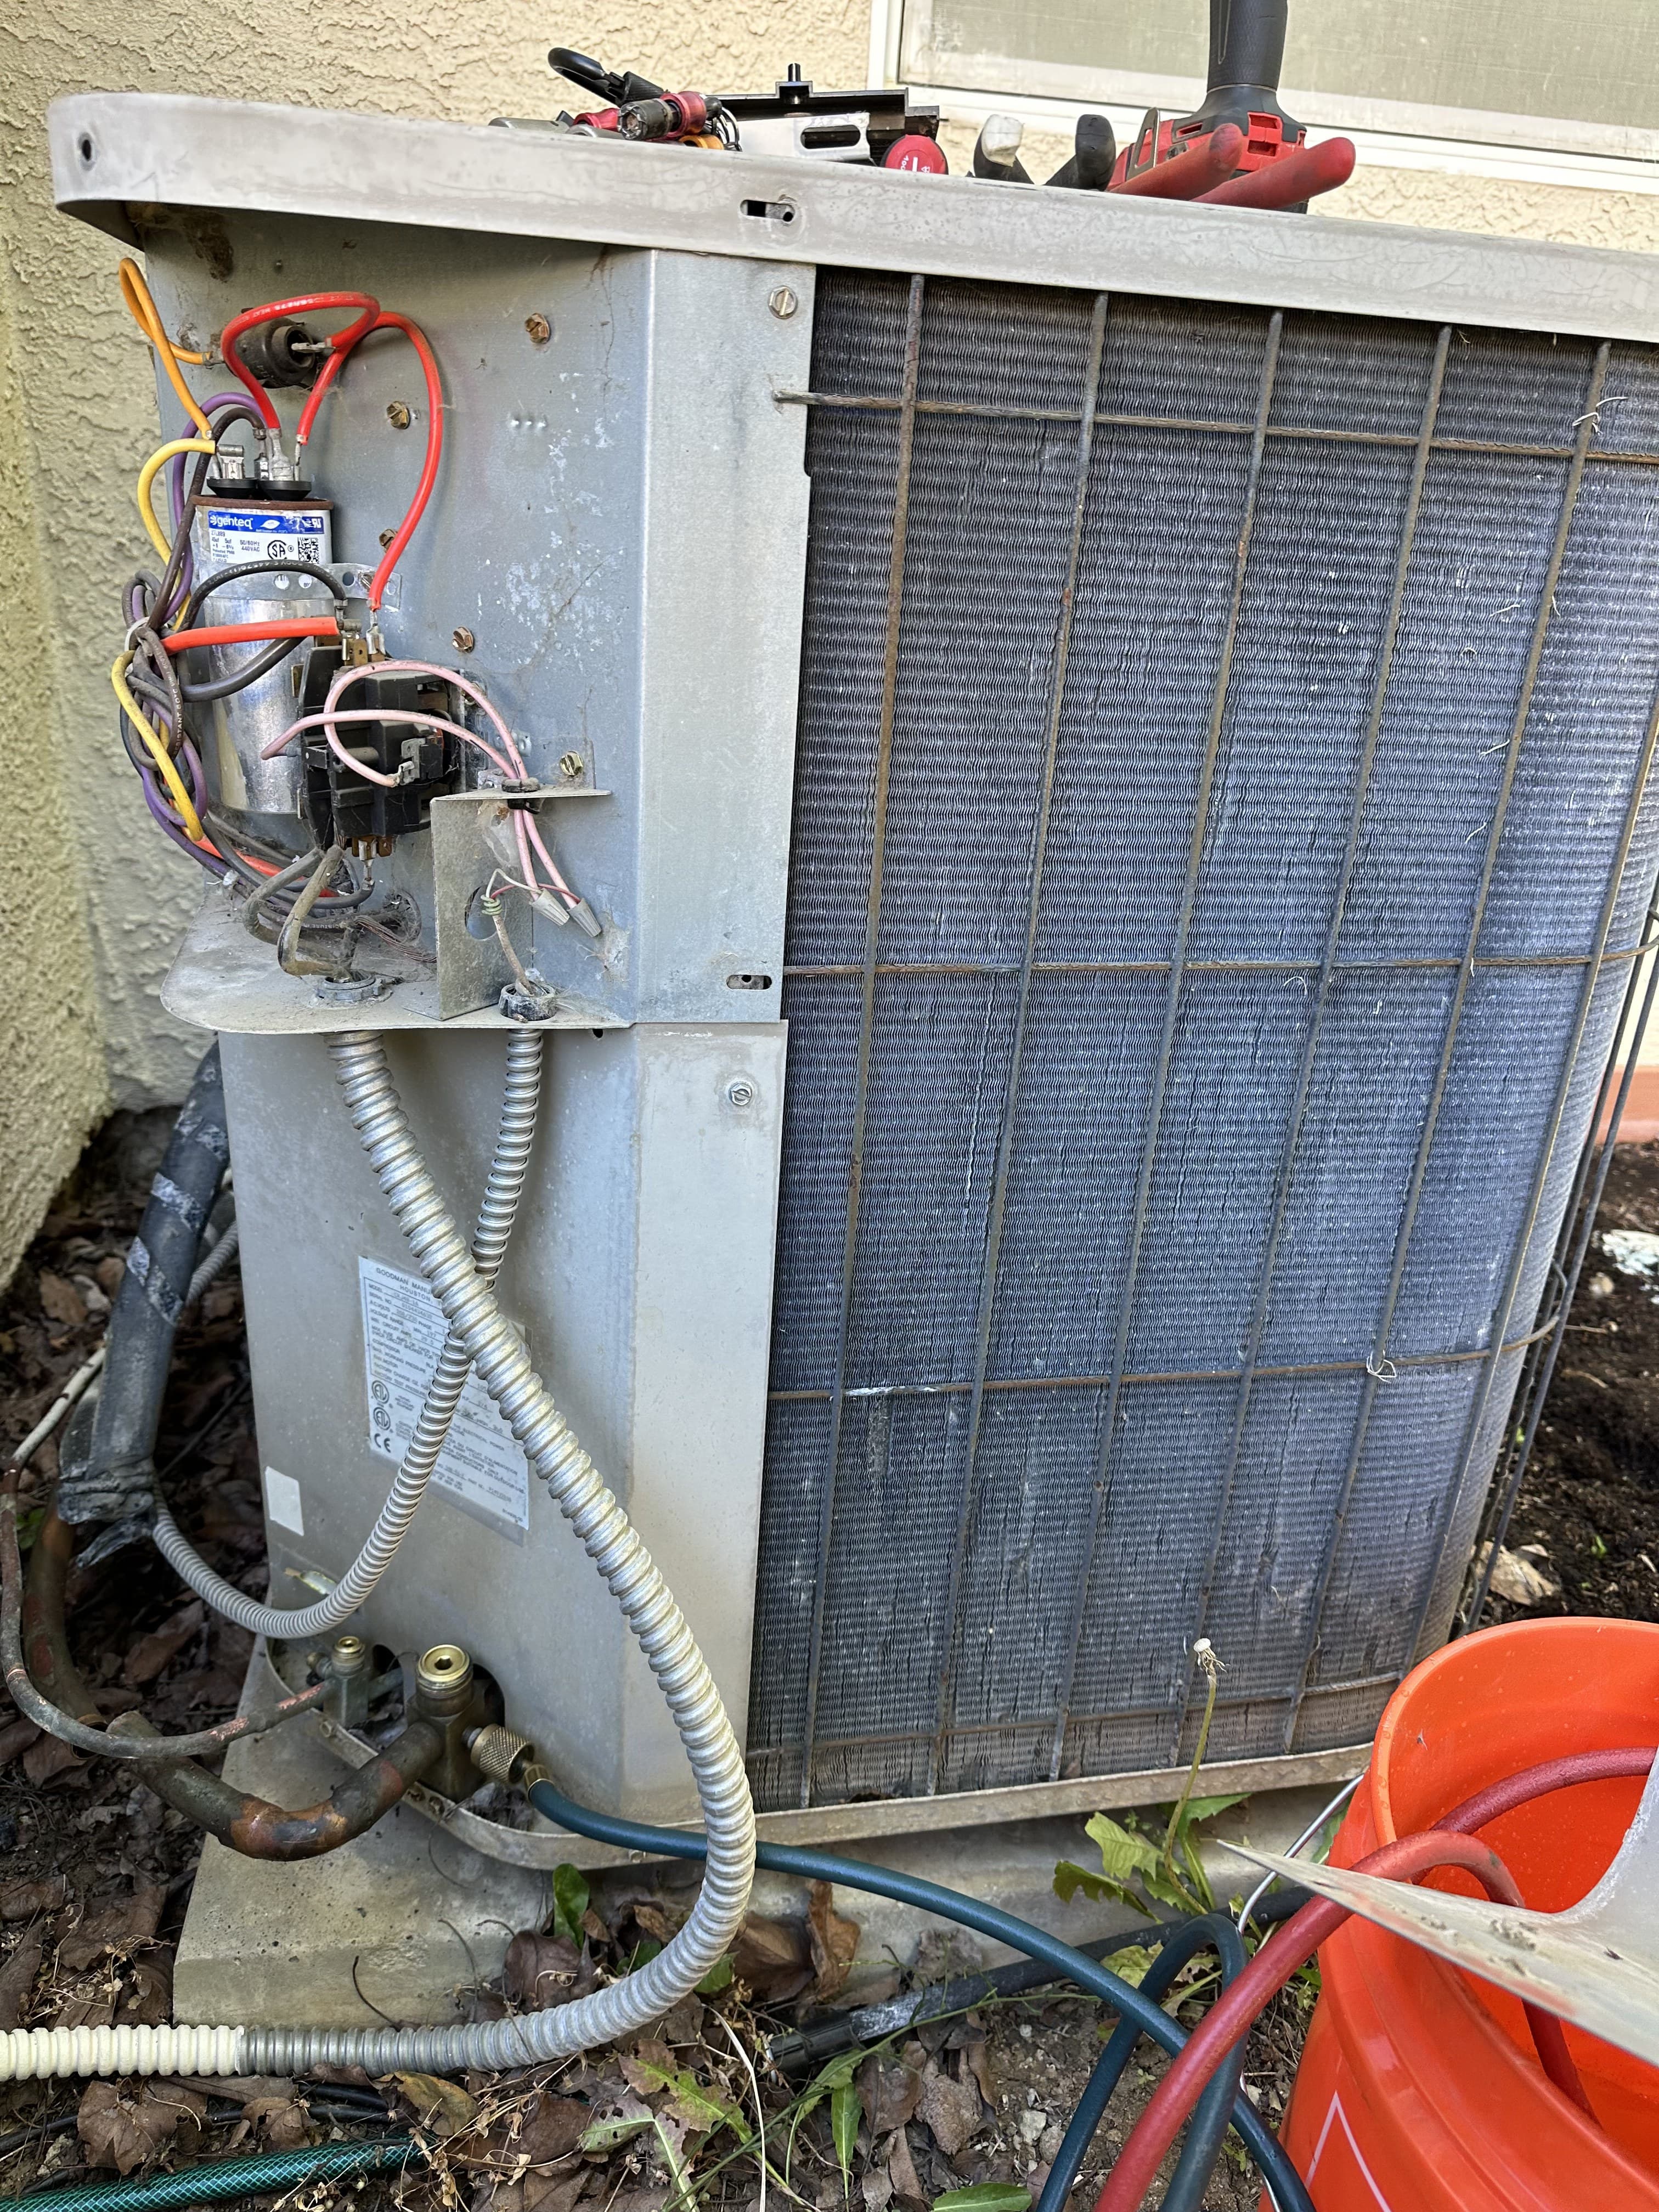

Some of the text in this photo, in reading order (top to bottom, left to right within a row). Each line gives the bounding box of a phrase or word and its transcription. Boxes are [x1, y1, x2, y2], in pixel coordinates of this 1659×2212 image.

[217, 517, 253, 530] genteq
[376, 1267, 430, 1294] GOODMAN MANU
